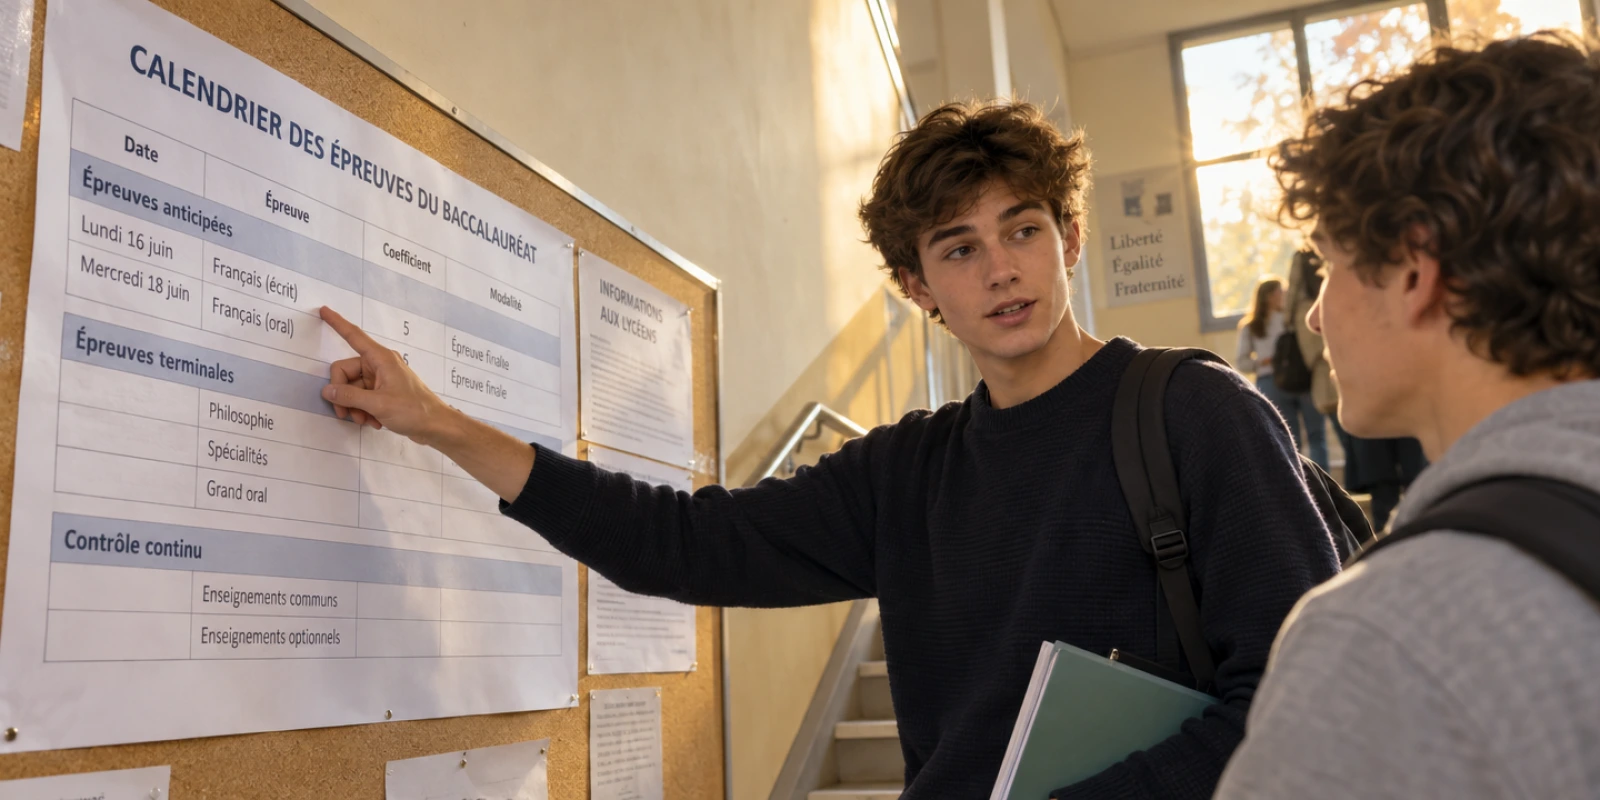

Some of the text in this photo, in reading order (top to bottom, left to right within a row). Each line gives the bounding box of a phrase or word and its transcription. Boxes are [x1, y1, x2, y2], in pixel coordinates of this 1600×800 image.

[125, 135, 158, 163] Date
[130, 45, 537, 264] CALENDRIER DES ÉPREUVES DU BACCALAURÉAT
[83, 165, 233, 237] Épreuves anticipées
[266, 190, 310, 223] Épreuve
[82, 215, 173, 259] Lundi 16 juin
[1110, 229, 1164, 251] Liberté
[383, 243, 431, 274] Coefficient
[1112, 253, 1164, 277] Égalité
[81, 255, 190, 301] Mercredi 18 juin
[213, 257, 298, 303] Français (écrit)
[1114, 273, 1186, 298] Fraternité
[600, 279, 663, 323] INFORMATIONS
[212, 297, 294, 339] Français (oral)
[403, 320, 409, 336] 5
[600, 306, 620, 330] AUX
[622, 318, 656, 343] LYCÉENS
[76, 326, 234, 383] Épreuves terminales
[452, 335, 483, 361] Épreuve
[451, 367, 507, 399] Épreuve finale
[209, 402, 274, 430] Philosophie
[207, 440, 268, 466] Spécialités
[207, 480, 267, 503] Grand oral
[64, 529, 202, 559] Contrôle continu
[202, 585, 338, 608] Enseignements communs
[201, 627, 341, 648] Enseignements optionnels
